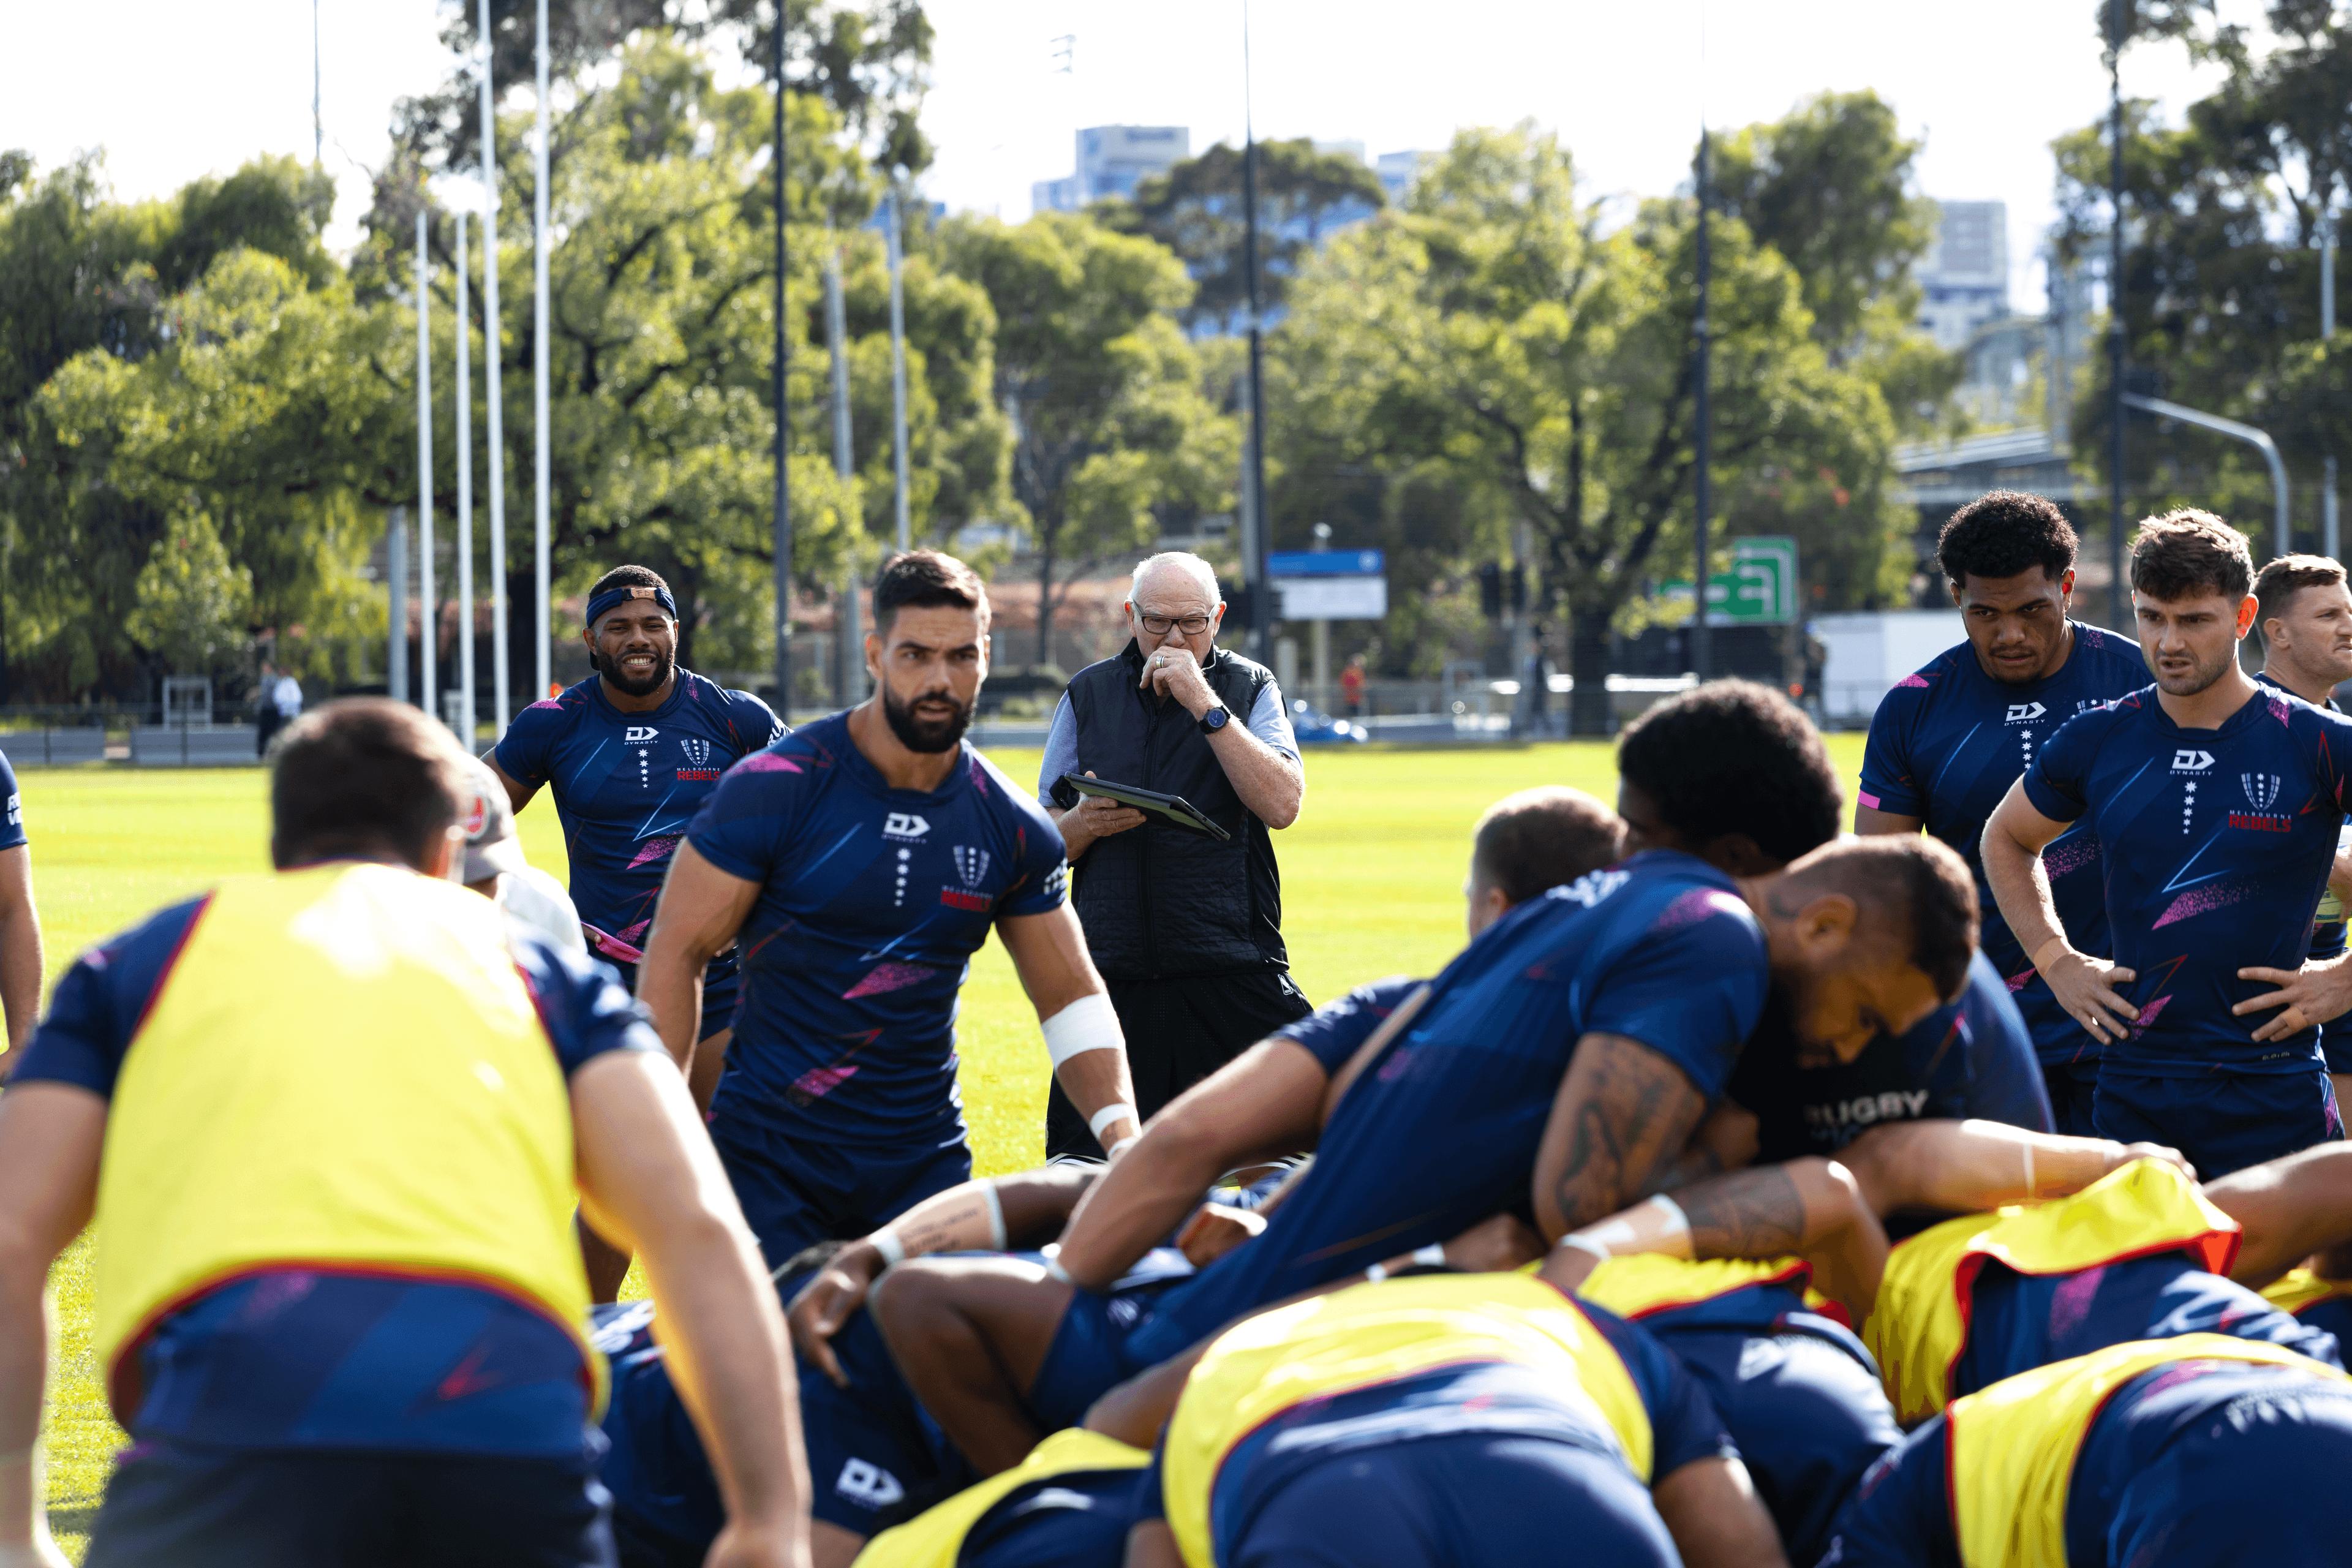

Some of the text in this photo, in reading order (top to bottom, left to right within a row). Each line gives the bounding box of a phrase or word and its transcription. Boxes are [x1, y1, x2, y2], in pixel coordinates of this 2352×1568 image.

[677, 771, 720, 781] REBELS
[2230, 810, 2291, 820] MELBOURNE
[2229, 814, 2291, 832] REBELS
